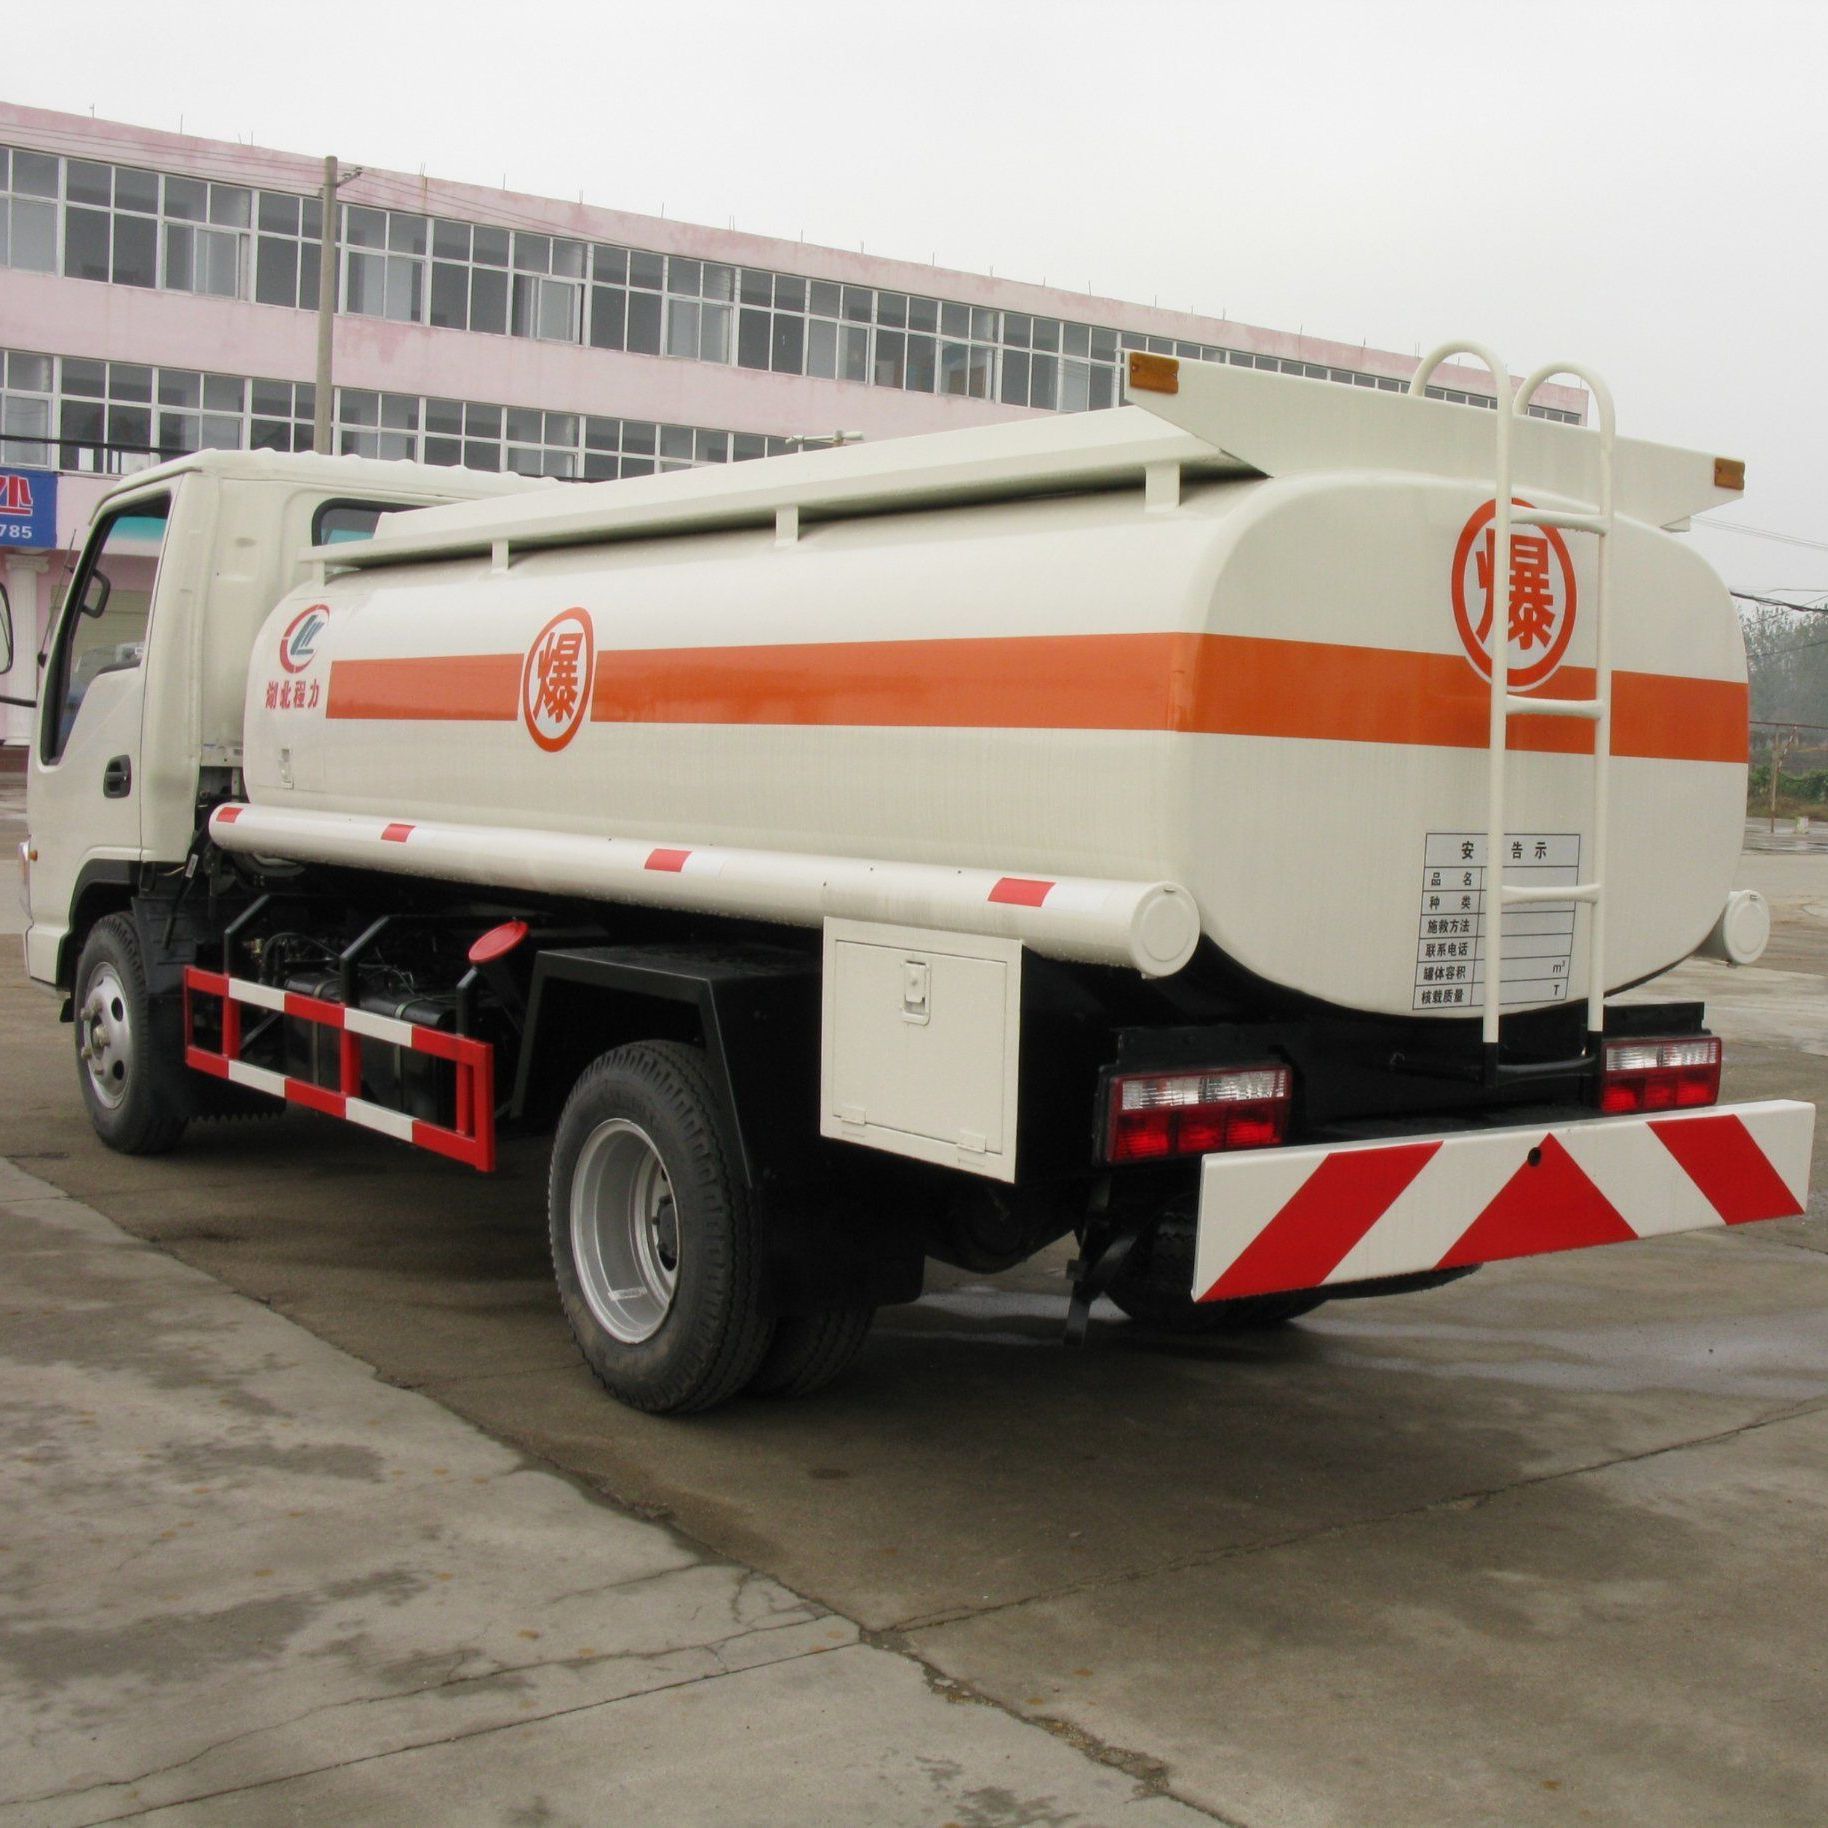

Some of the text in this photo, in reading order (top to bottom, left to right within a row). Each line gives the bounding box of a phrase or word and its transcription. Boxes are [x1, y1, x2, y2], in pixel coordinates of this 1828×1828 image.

[1475, 527, 1556, 650] 爆
[533, 632, 584, 724] 爆
[265, 678, 320, 709] 湖北程力
[1461, 840, 1547, 860] 安告示
[1427, 918, 1470, 934] 施救方法
[1425, 942, 1468, 958] 联系电话
[1423, 965, 1466, 981] 罐体容积
[1421, 988, 1464, 1005] 核载质量
[1553, 984, 1560, 996] T
